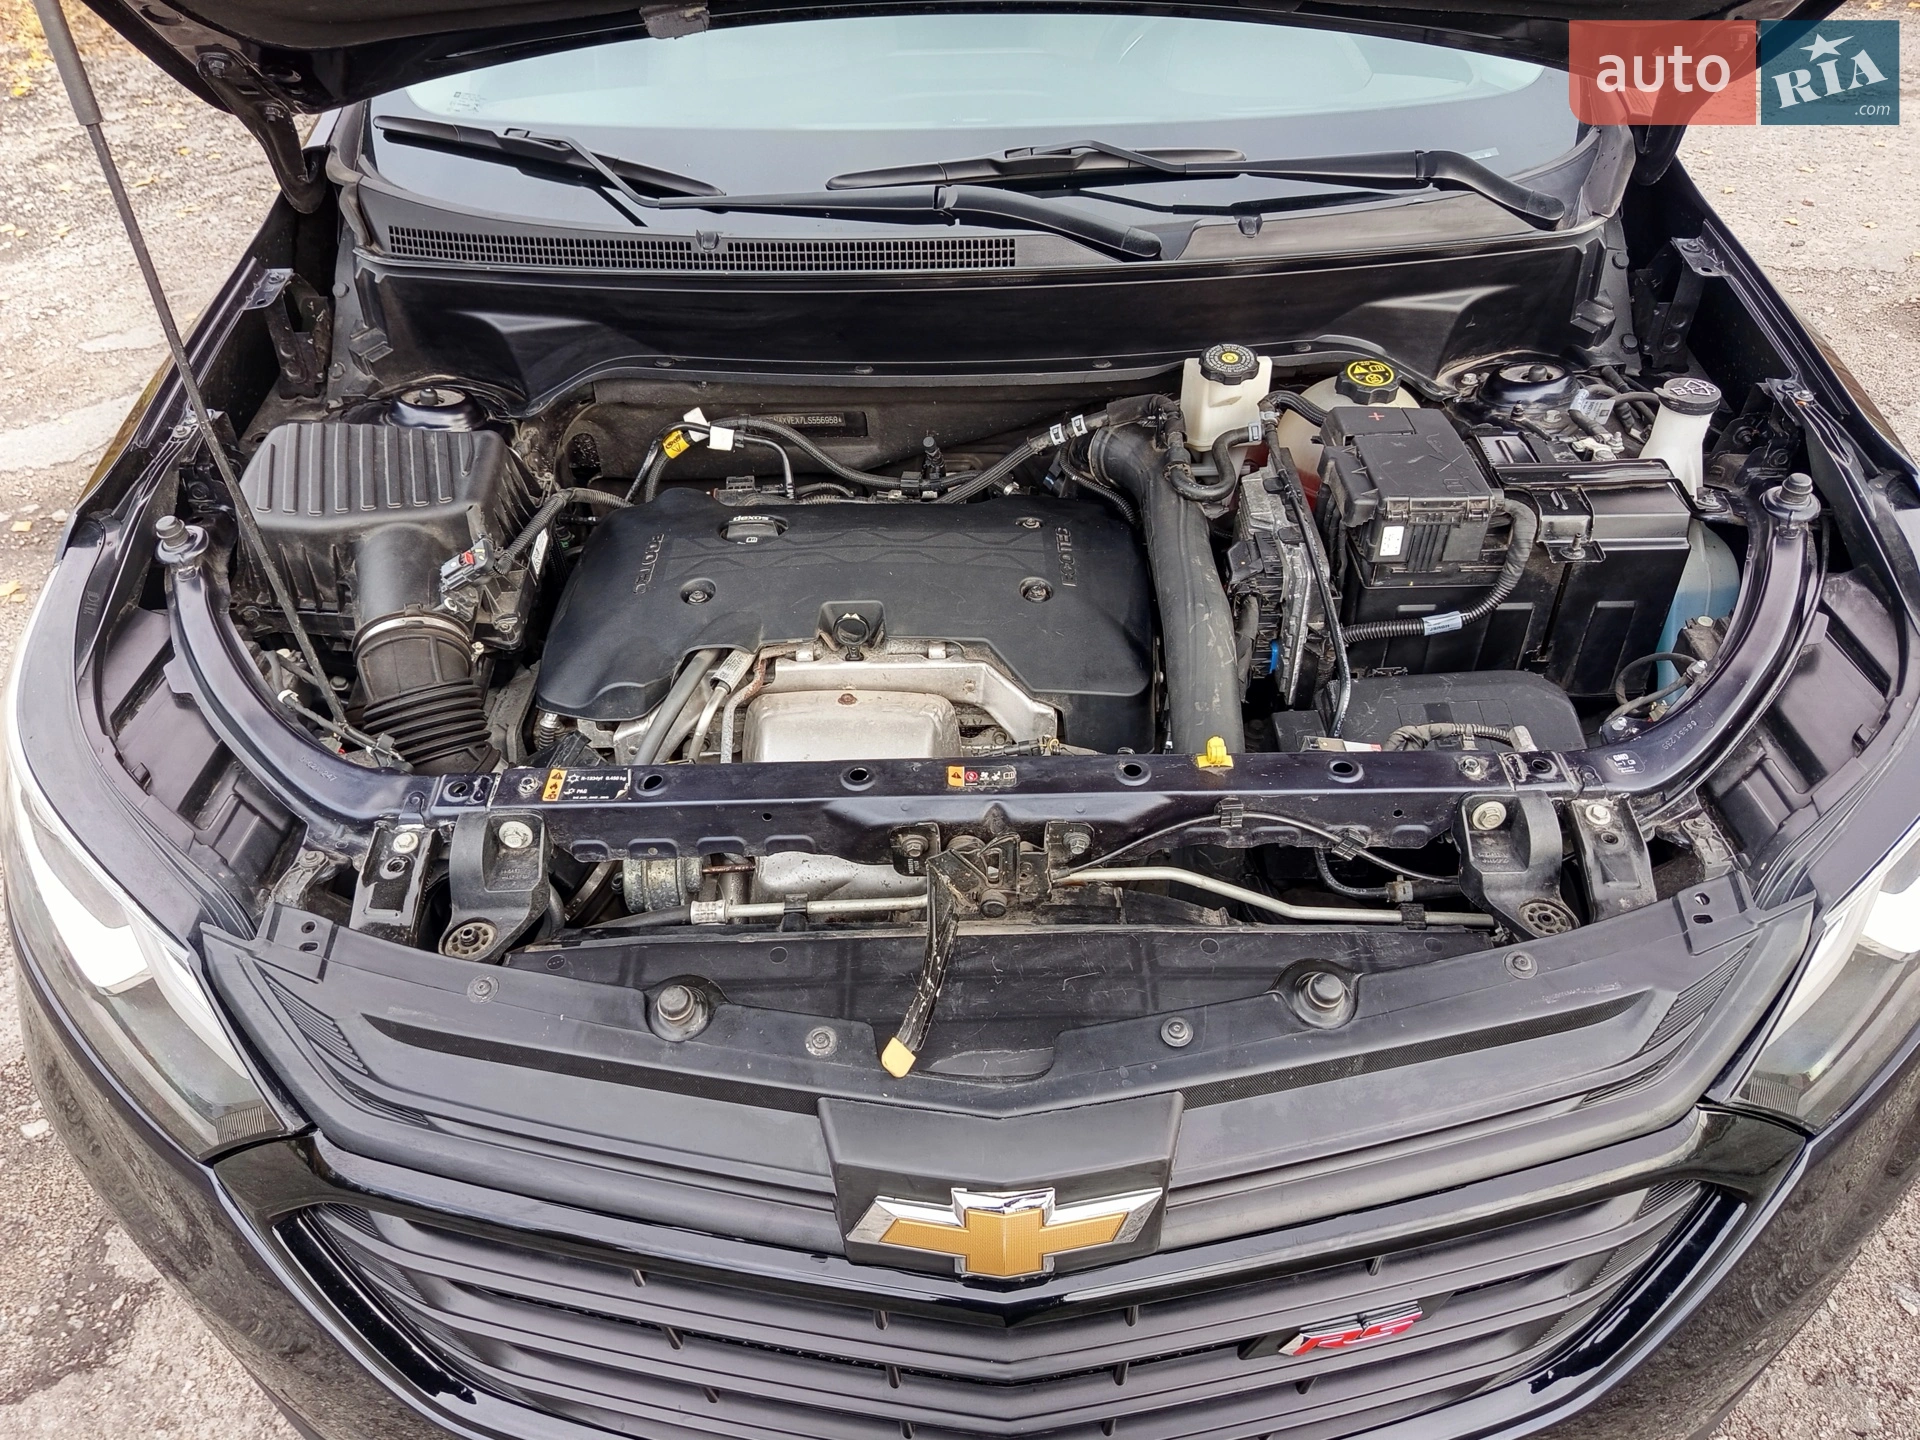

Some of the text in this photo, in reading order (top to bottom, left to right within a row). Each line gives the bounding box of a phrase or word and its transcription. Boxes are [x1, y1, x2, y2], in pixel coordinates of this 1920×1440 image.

[633, 533, 665, 595] ECOTEC
[1055, 527, 1078, 587] ECOTEC
[1282, 1303, 1424, 1356] RS
